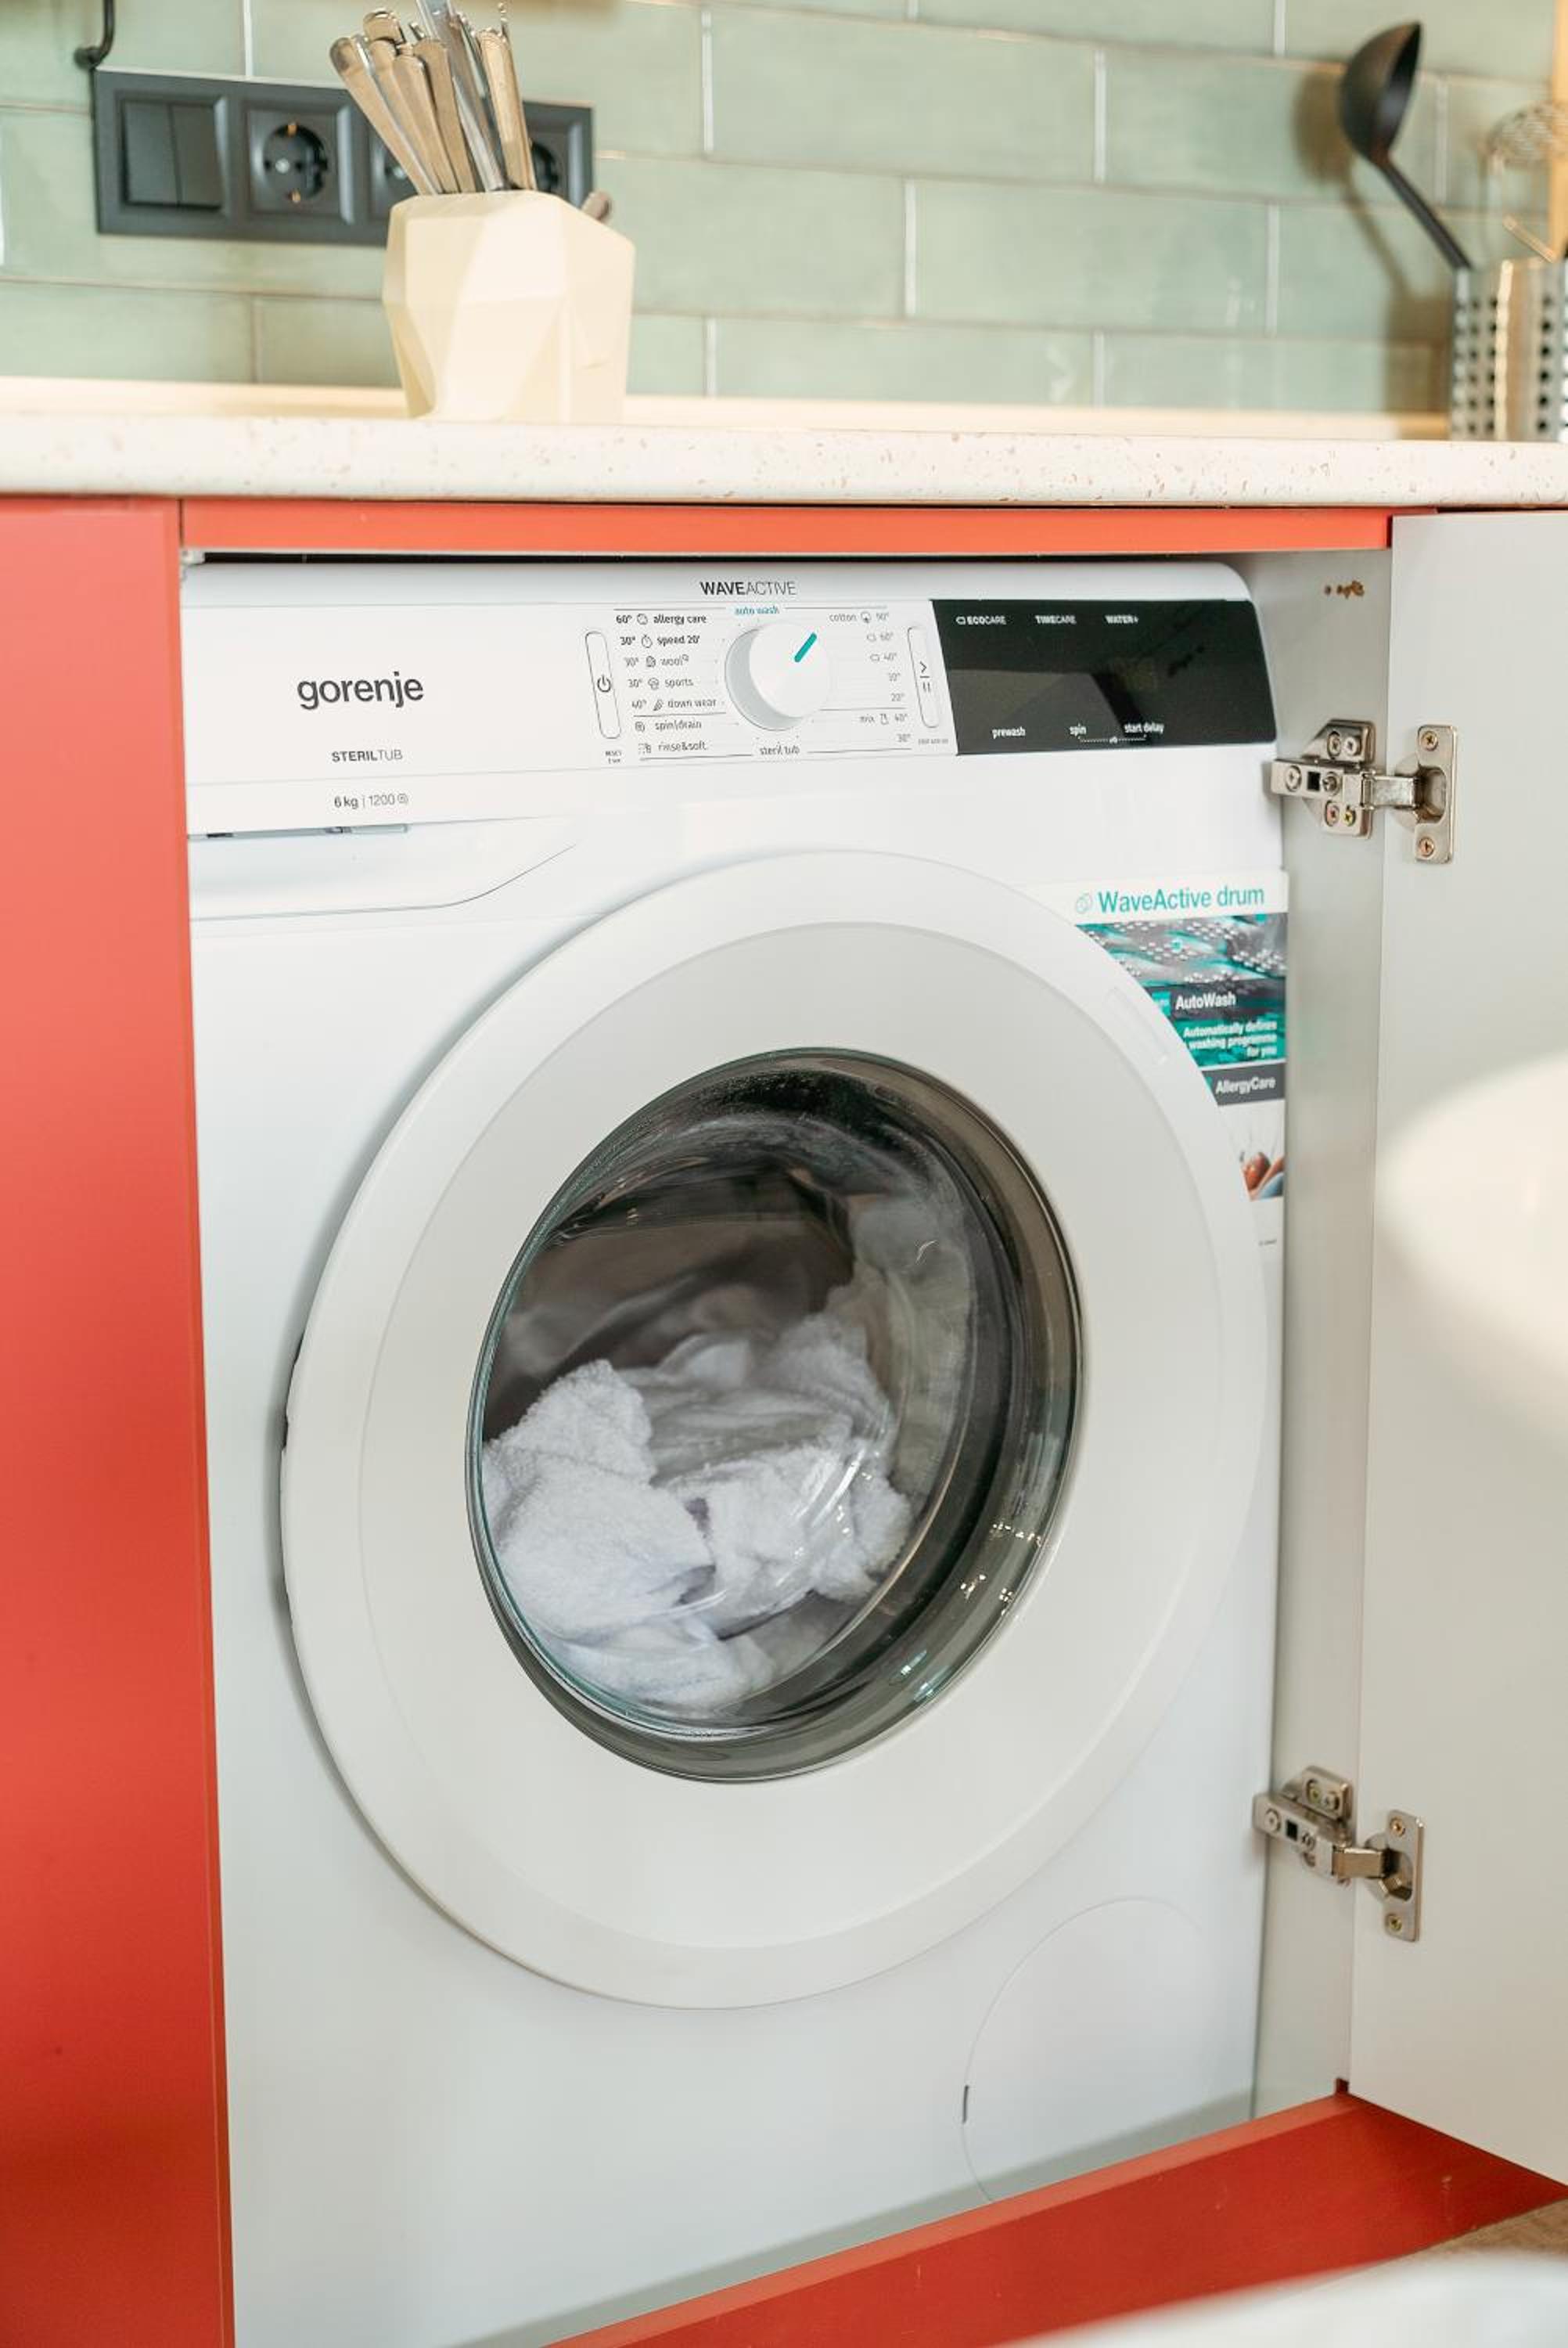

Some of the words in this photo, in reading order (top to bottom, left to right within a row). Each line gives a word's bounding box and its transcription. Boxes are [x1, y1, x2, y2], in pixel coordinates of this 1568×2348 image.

[700, 582, 797, 596] WAVEACTIVE
[735, 607, 755, 615] auto
[757, 605, 779, 614] wash
[653, 614, 685, 625] allergy
[687, 615, 707, 624] care
[829, 613, 857, 622] cotton
[966, 616, 1007, 625] ECOCARE
[1035, 615, 1077, 625] TIMECARE
[1105, 614, 1139, 625] WATER+
[656, 635, 685, 646] speed
[660, 656, 683, 666] wool
[664, 678, 693, 688] sports
[297, 671, 425, 711] gorenje
[667, 700, 692, 708] down
[860, 714, 876, 723] mix
[991, 726, 1027, 740] prewash
[1069, 725, 1087, 736] spin
[1124, 722, 1142, 733] start
[1143, 722, 1165, 735] delay
[760, 744, 783, 755] steril
[784, 744, 800, 755] tub
[331, 750, 404, 763] STERILTUB
[334, 798, 342, 808] 6
[343, 796, 359, 810] kg
[369, 794, 395, 806] 1200
[1098, 888, 1212, 914] WaveActive
[1217, 886, 1264, 906] drum
[1174, 992, 1236, 1010] AutoWash
[1183, 1023, 1244, 1039] Automatically
[1245, 1020, 1277, 1032] defines
[1189, 1036, 1226, 1050] washing
[1228, 1033, 1277, 1048] programme
[1246, 1046, 1259, 1057] for
[1261, 1045, 1277, 1058] you
[1215, 1077, 1276, 1095] AllergyCare
